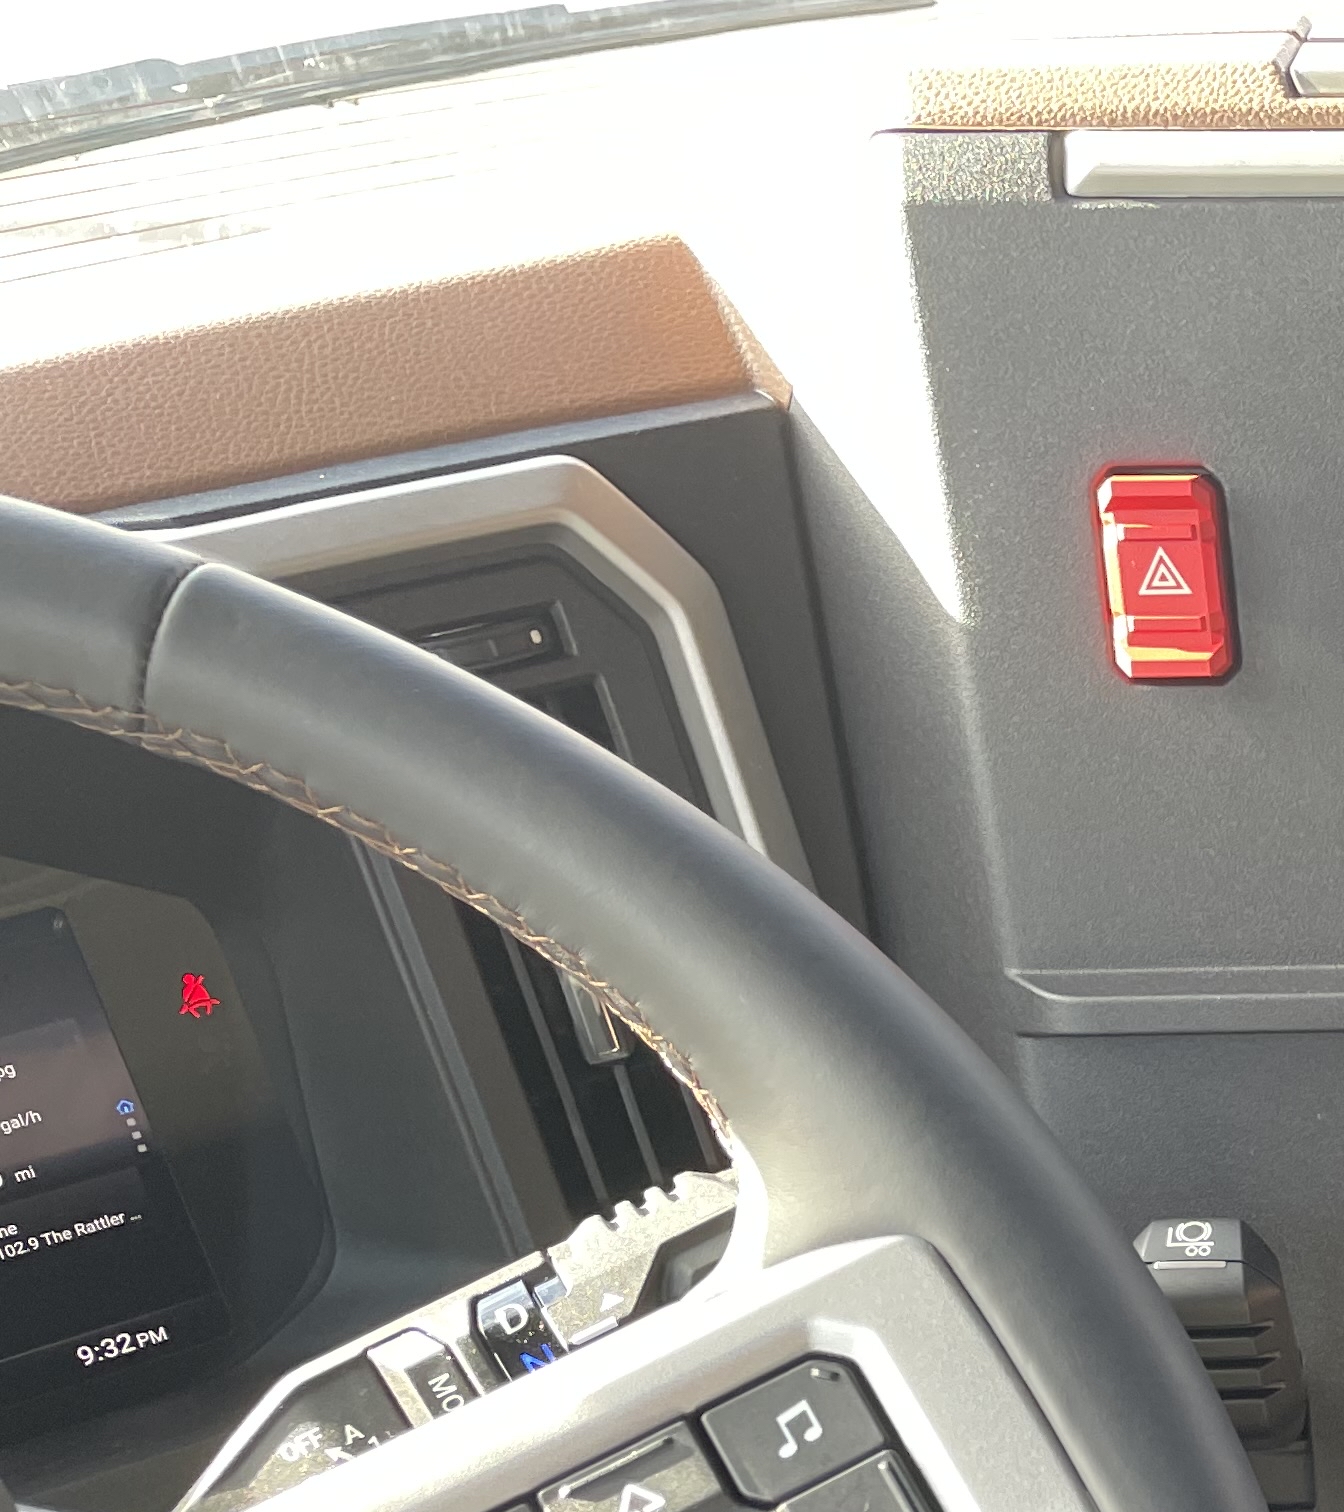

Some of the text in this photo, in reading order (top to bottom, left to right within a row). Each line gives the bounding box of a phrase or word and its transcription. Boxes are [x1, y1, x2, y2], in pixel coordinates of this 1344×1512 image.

[0, 1110, 42, 1135] gal/h
[14, 1165, 36, 1183] mi
[39, 1229, 73, 1246] The
[73, 1212, 126, 1237] Rattler
[76, 1325, 169, 1367] 9:32 PM
[279, 1426, 323, 1462] OFF
